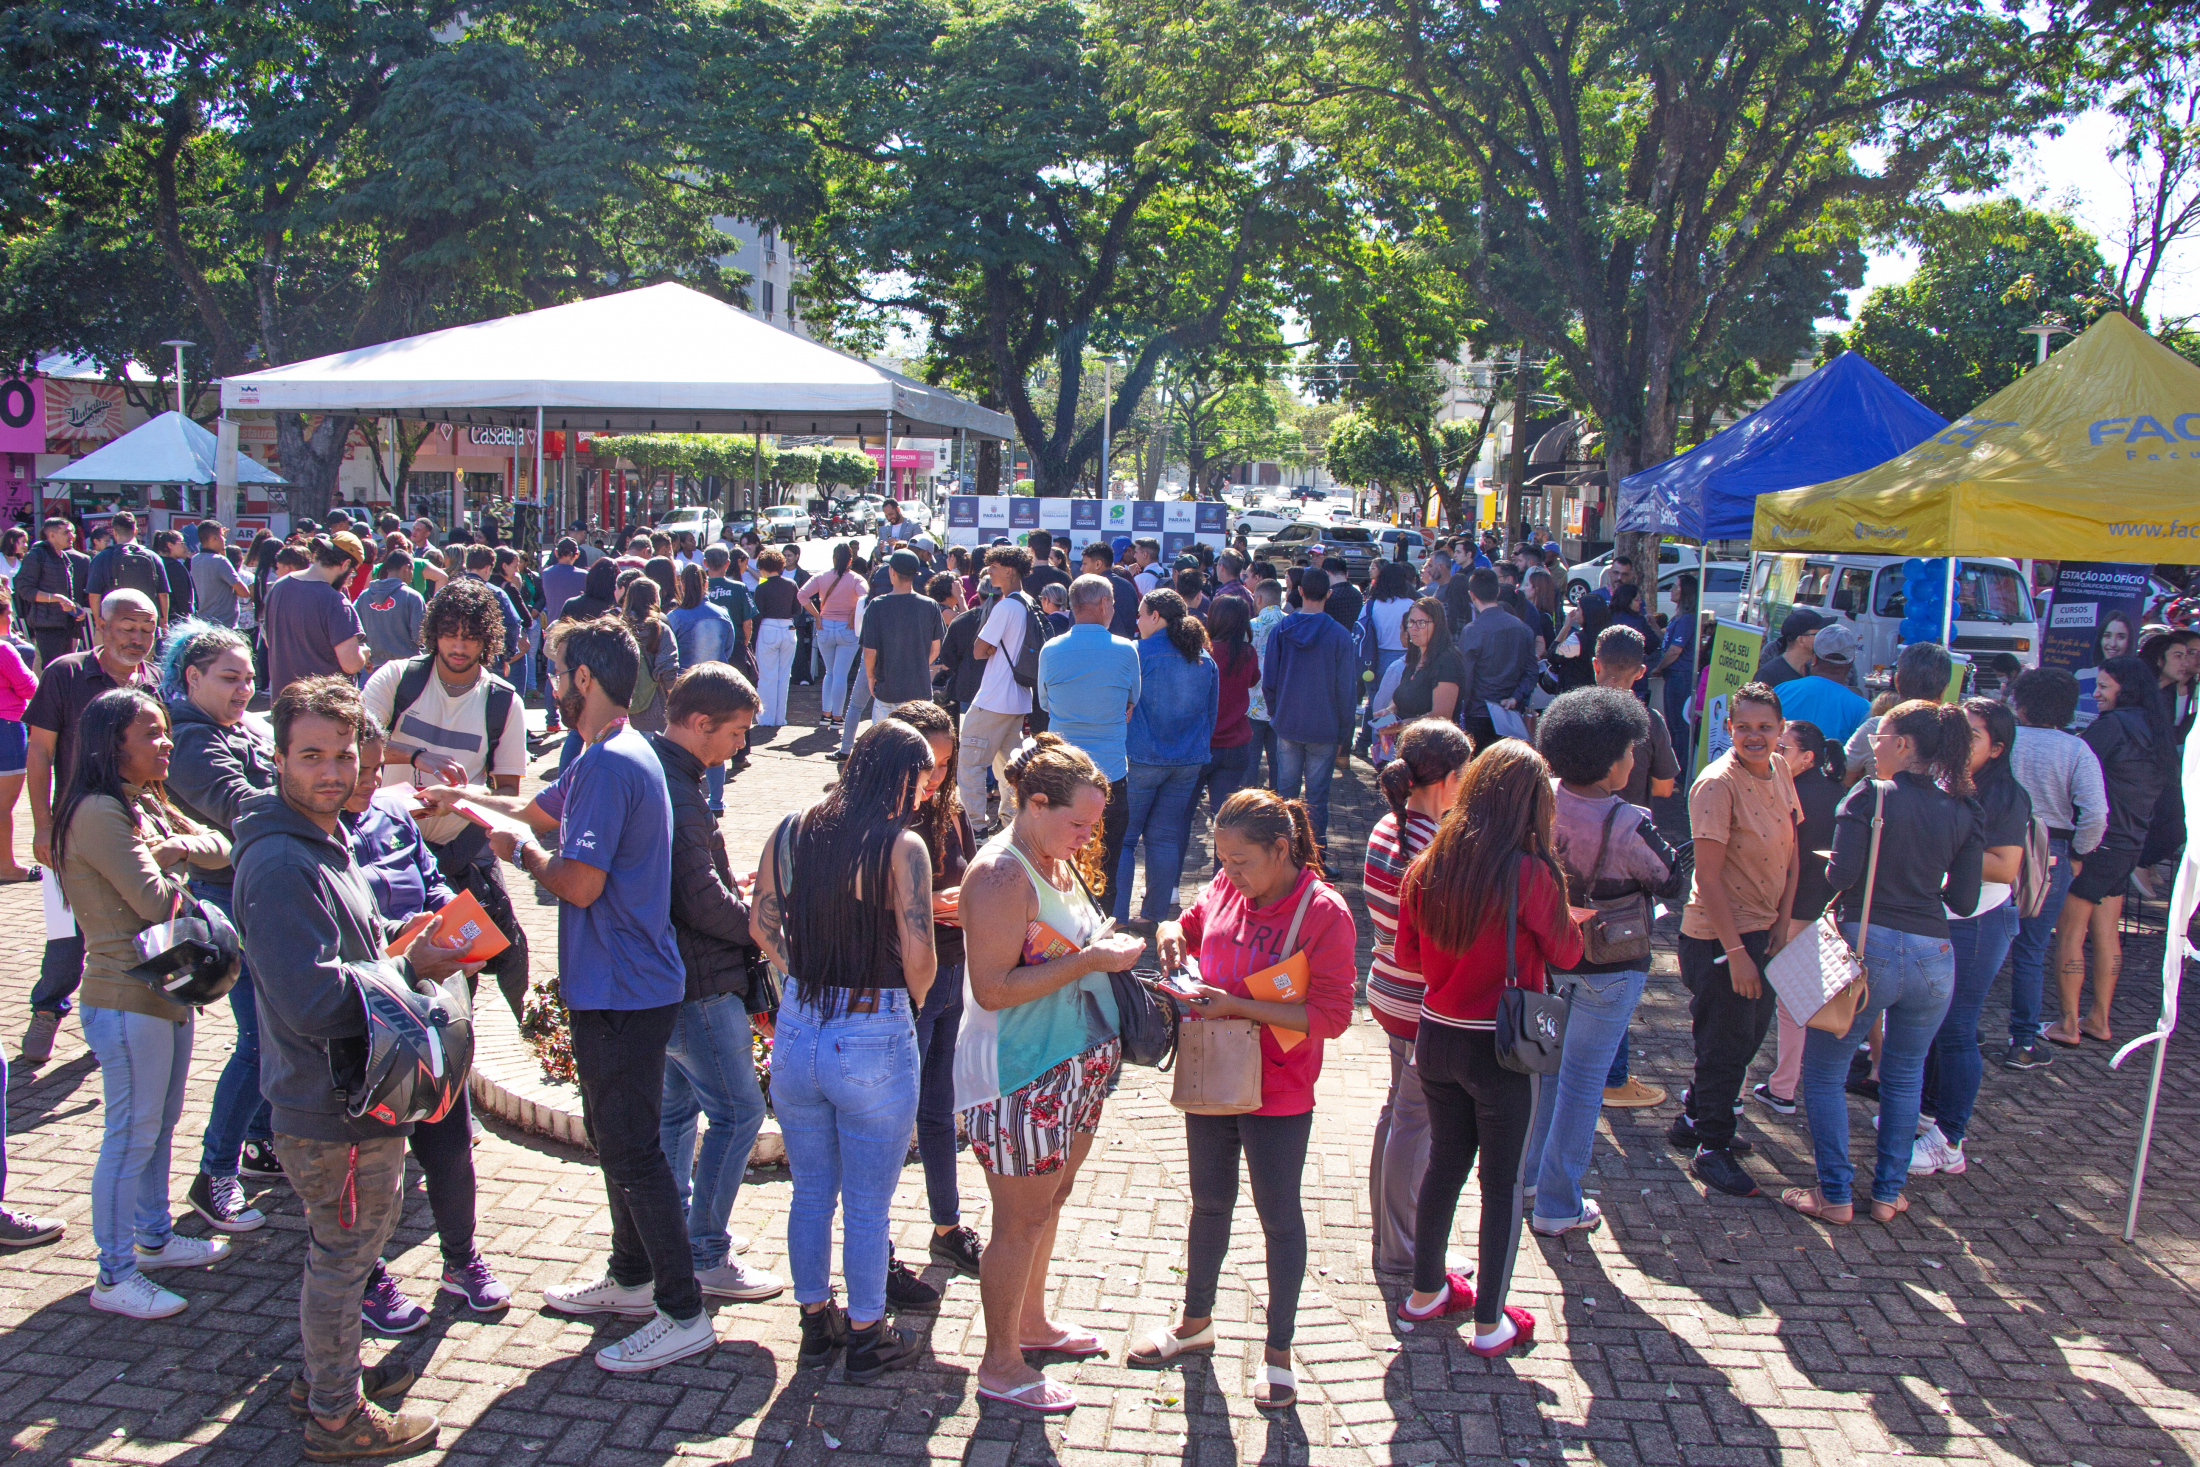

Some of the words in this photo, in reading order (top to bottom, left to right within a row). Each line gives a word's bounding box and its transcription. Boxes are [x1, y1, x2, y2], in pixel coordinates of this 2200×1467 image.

[237, 426, 278, 439] staura
[470, 426, 525, 446] Casaela
[10, 486, 18, 496] 7
[236, 529, 254, 538] AR
[2060, 570, 2098, 582] ESTAÇÃO
[2099, 573, 2113, 582] DO
[2114, 574, 2146, 584] OFÍCIO
[2060, 606, 2088, 614] CURSOS
[2054, 616, 2094, 624] GRATUITOS
[1722, 640, 1736, 656] FAÇA
[1737, 645, 1749, 658] SEU
[1719, 655, 1750, 674] CURRÍCULO
[1725, 672, 1740, 687] AQUI
[366, 986, 430, 1048] TORK
